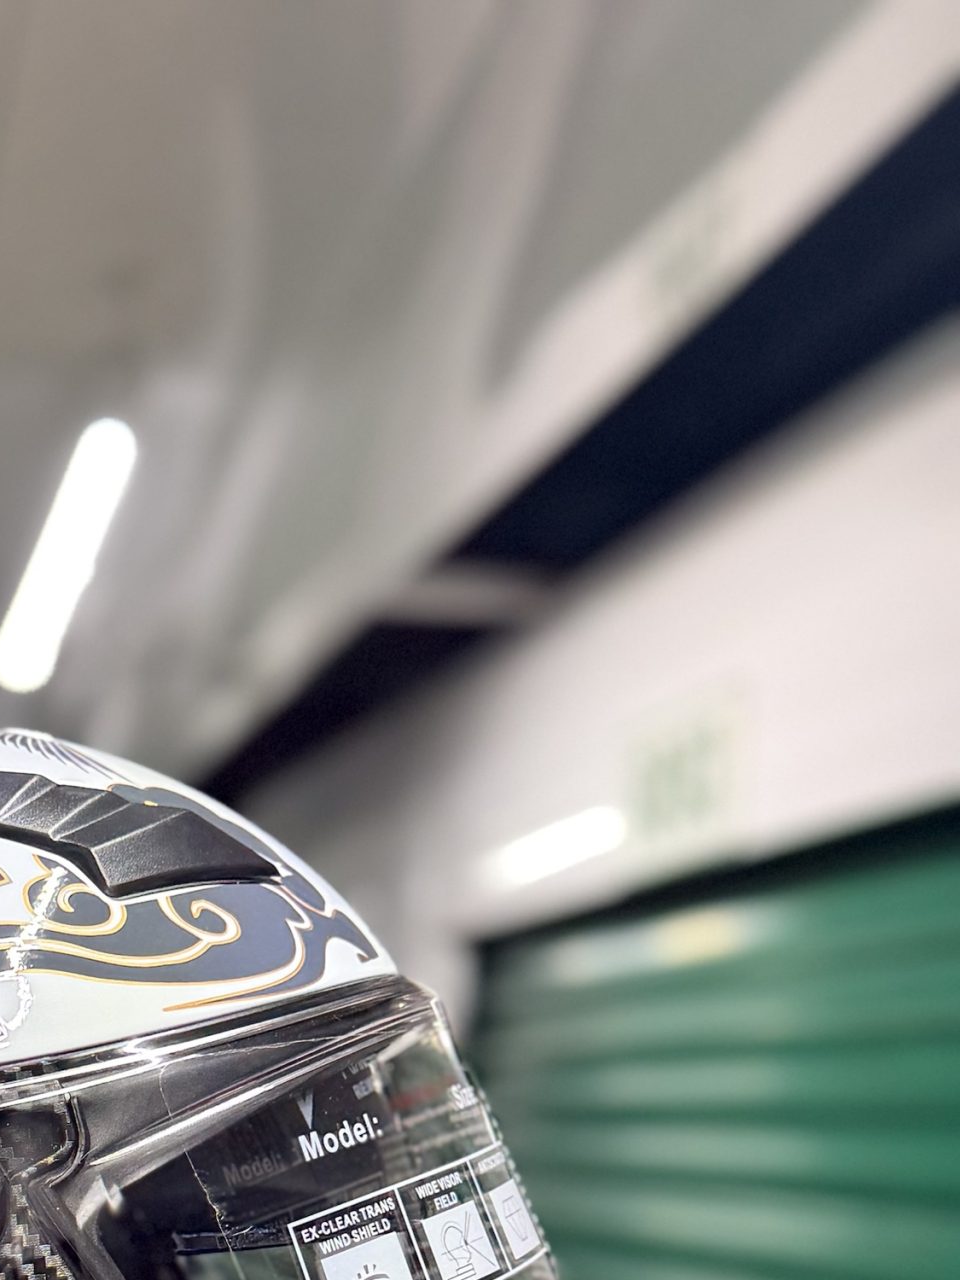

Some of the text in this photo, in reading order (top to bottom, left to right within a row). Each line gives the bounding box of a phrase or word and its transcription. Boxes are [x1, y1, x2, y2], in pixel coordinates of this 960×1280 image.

[298, 1113, 383, 1162] Model:
[414, 1171, 463, 1200] WIDE VISOR
[434, 1191, 458, 1210] FIELD
[301, 1197, 396, 1243] EX-CLEAR TRANS
[319, 1218, 391, 1255] WIND SHIELD
